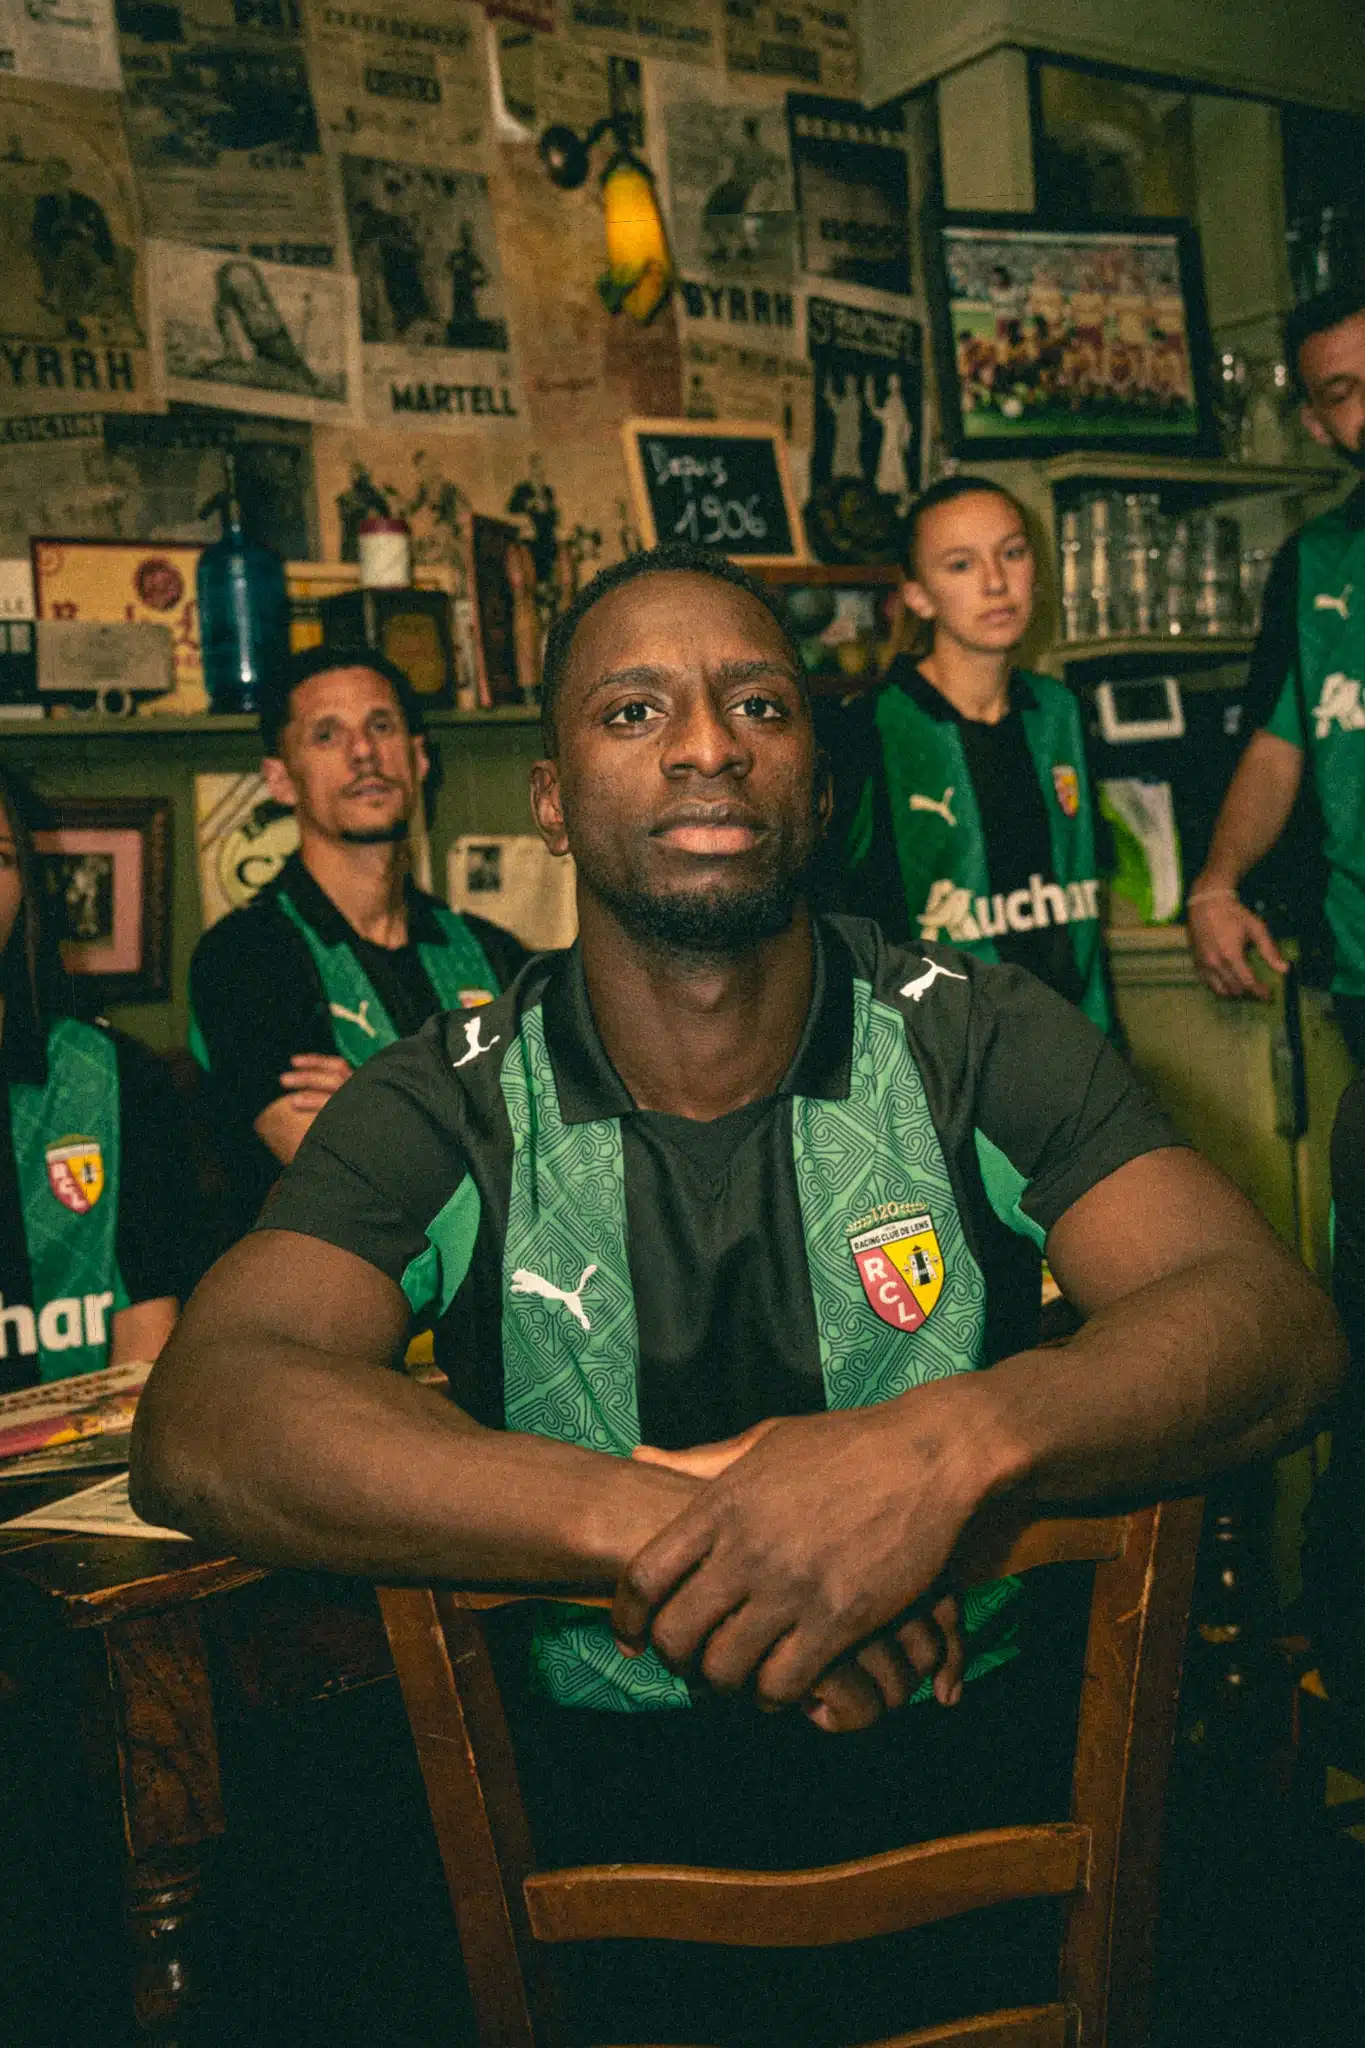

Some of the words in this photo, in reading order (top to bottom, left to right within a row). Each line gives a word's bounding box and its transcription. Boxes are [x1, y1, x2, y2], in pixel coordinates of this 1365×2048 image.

[682, 282, 794, 328] BYRRH
[390, 383, 518, 417] MARTELL
[673, 494, 768, 544] 1906
[871, 1201, 900, 1223] 120
[854, 1234, 881, 1251] RACING
[881, 1228, 900, 1243] CLUB
[900, 1226, 910, 1237] DE
[911, 1219, 930, 1233] LENS
